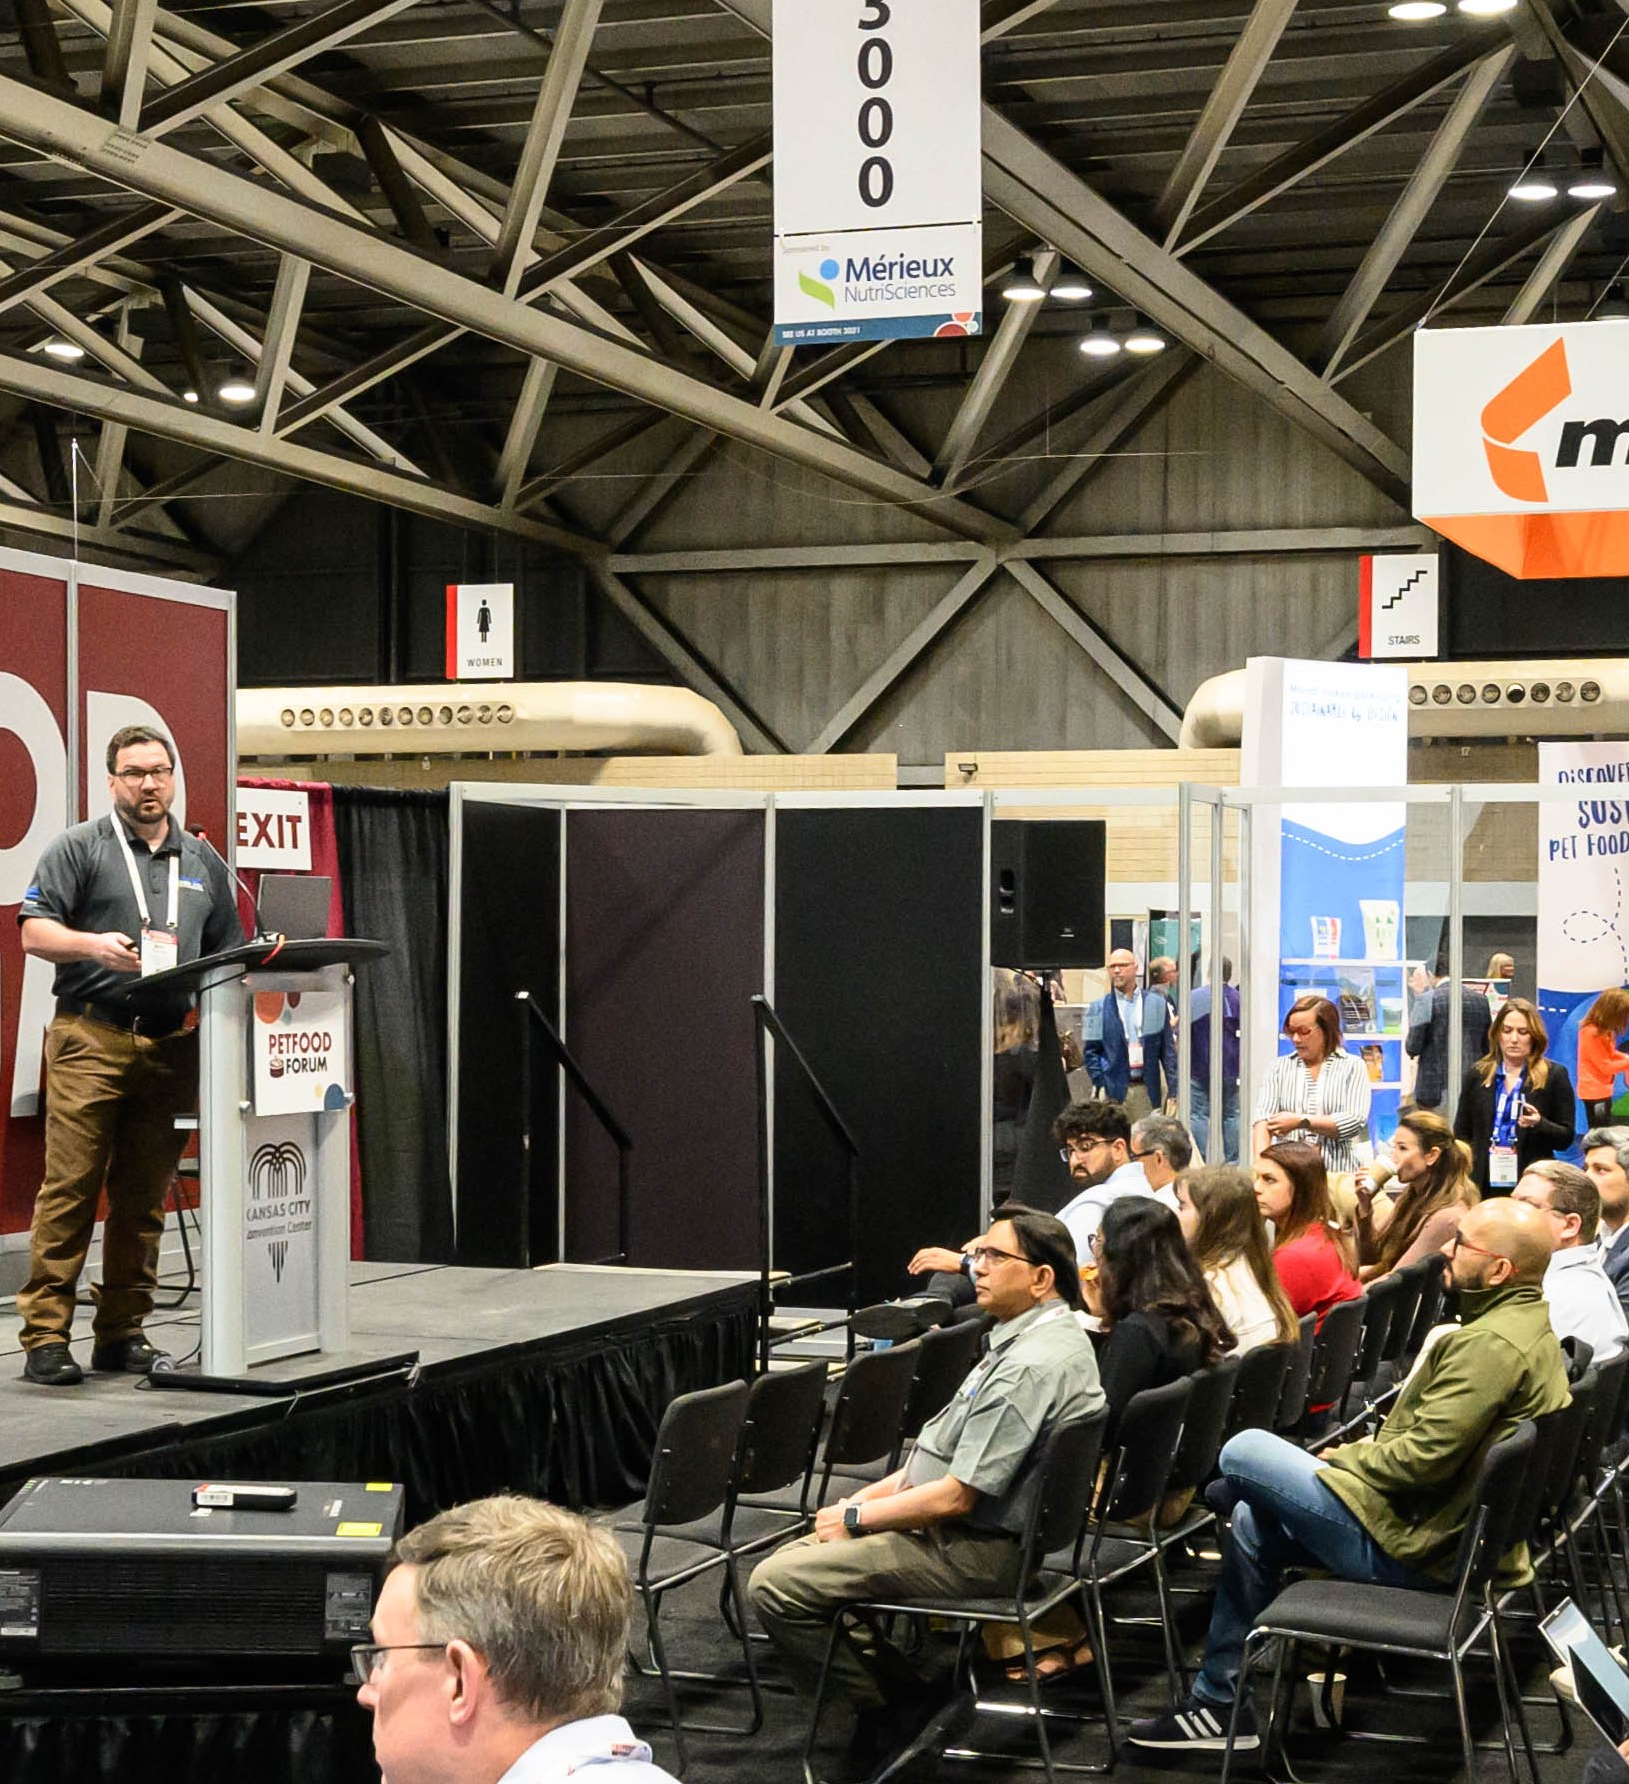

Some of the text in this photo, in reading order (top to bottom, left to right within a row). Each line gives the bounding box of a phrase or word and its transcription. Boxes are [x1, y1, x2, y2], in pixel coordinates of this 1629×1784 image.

[845, 252, 954, 283] Mérieux
[844, 281, 956, 303] NutriSciences
[1388, 635, 1421, 646] STAIRS
[467, 657, 503, 667] WOMEN
[236, 812, 302, 849] EXIT
[1549, 836, 1577, 861] PET
[268, 1031, 332, 1056] PETFOOD
[285, 1056, 328, 1074] FORUM
[287, 1200, 311, 1216] CITY
[287, 1219, 312, 1235] Center
